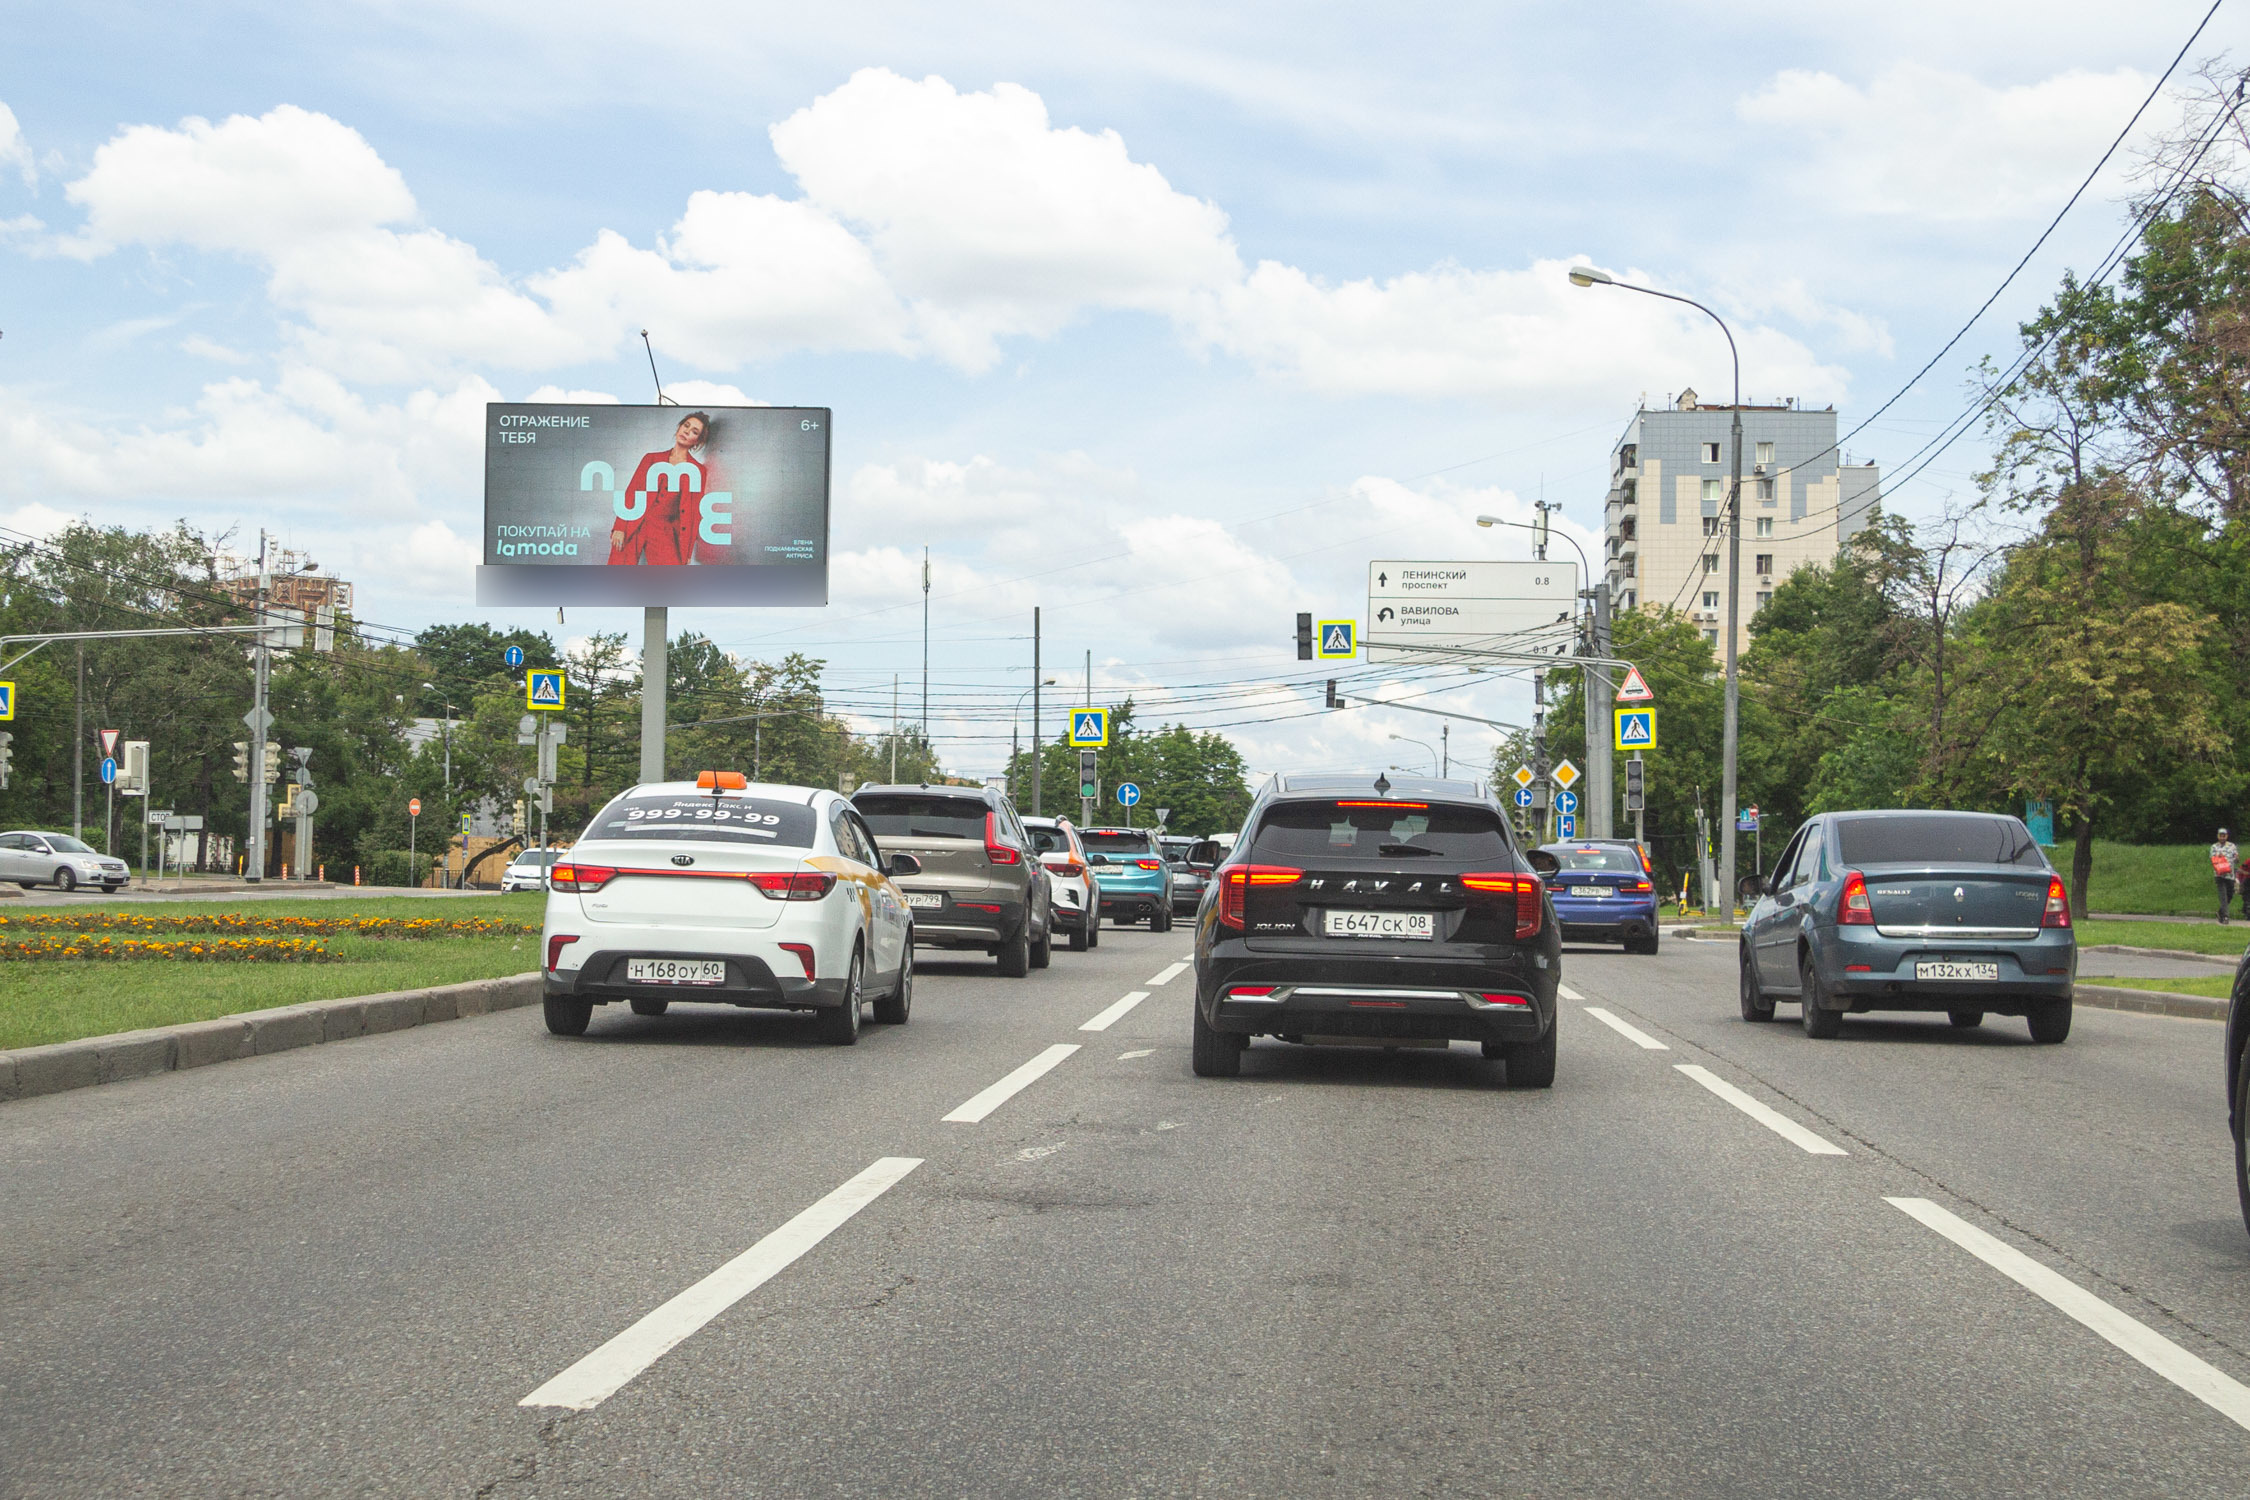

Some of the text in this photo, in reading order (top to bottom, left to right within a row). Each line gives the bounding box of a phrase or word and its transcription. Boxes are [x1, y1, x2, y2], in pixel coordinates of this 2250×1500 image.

[499, 415, 590, 428] ОТРАЖЕНИЕ
[801, 419, 819, 431] 6+
[499, 431, 536, 444] ТЕБЯ
[497, 523, 591, 538] ПОКУПАЙ НА
[496, 539, 578, 557] lamoda
[1401, 569, 1467, 580] ЛЕНИНСКИЙ
[1402, 581, 1448, 590] проспект
[1535, 577, 1550, 586] 0.8
[1401, 606, 1460, 616] ВАВИЛОВА
[1400, 617, 1431, 626] улица
[628, 808, 780, 826] 999-99-99
[1310, 879, 1452, 892] HAVAL
[1254, 923, 1296, 931] JOLION
[1409, 915, 1426, 929] 08
[703, 963, 719, 975] 60
[1974, 964, 1994, 975] 134
